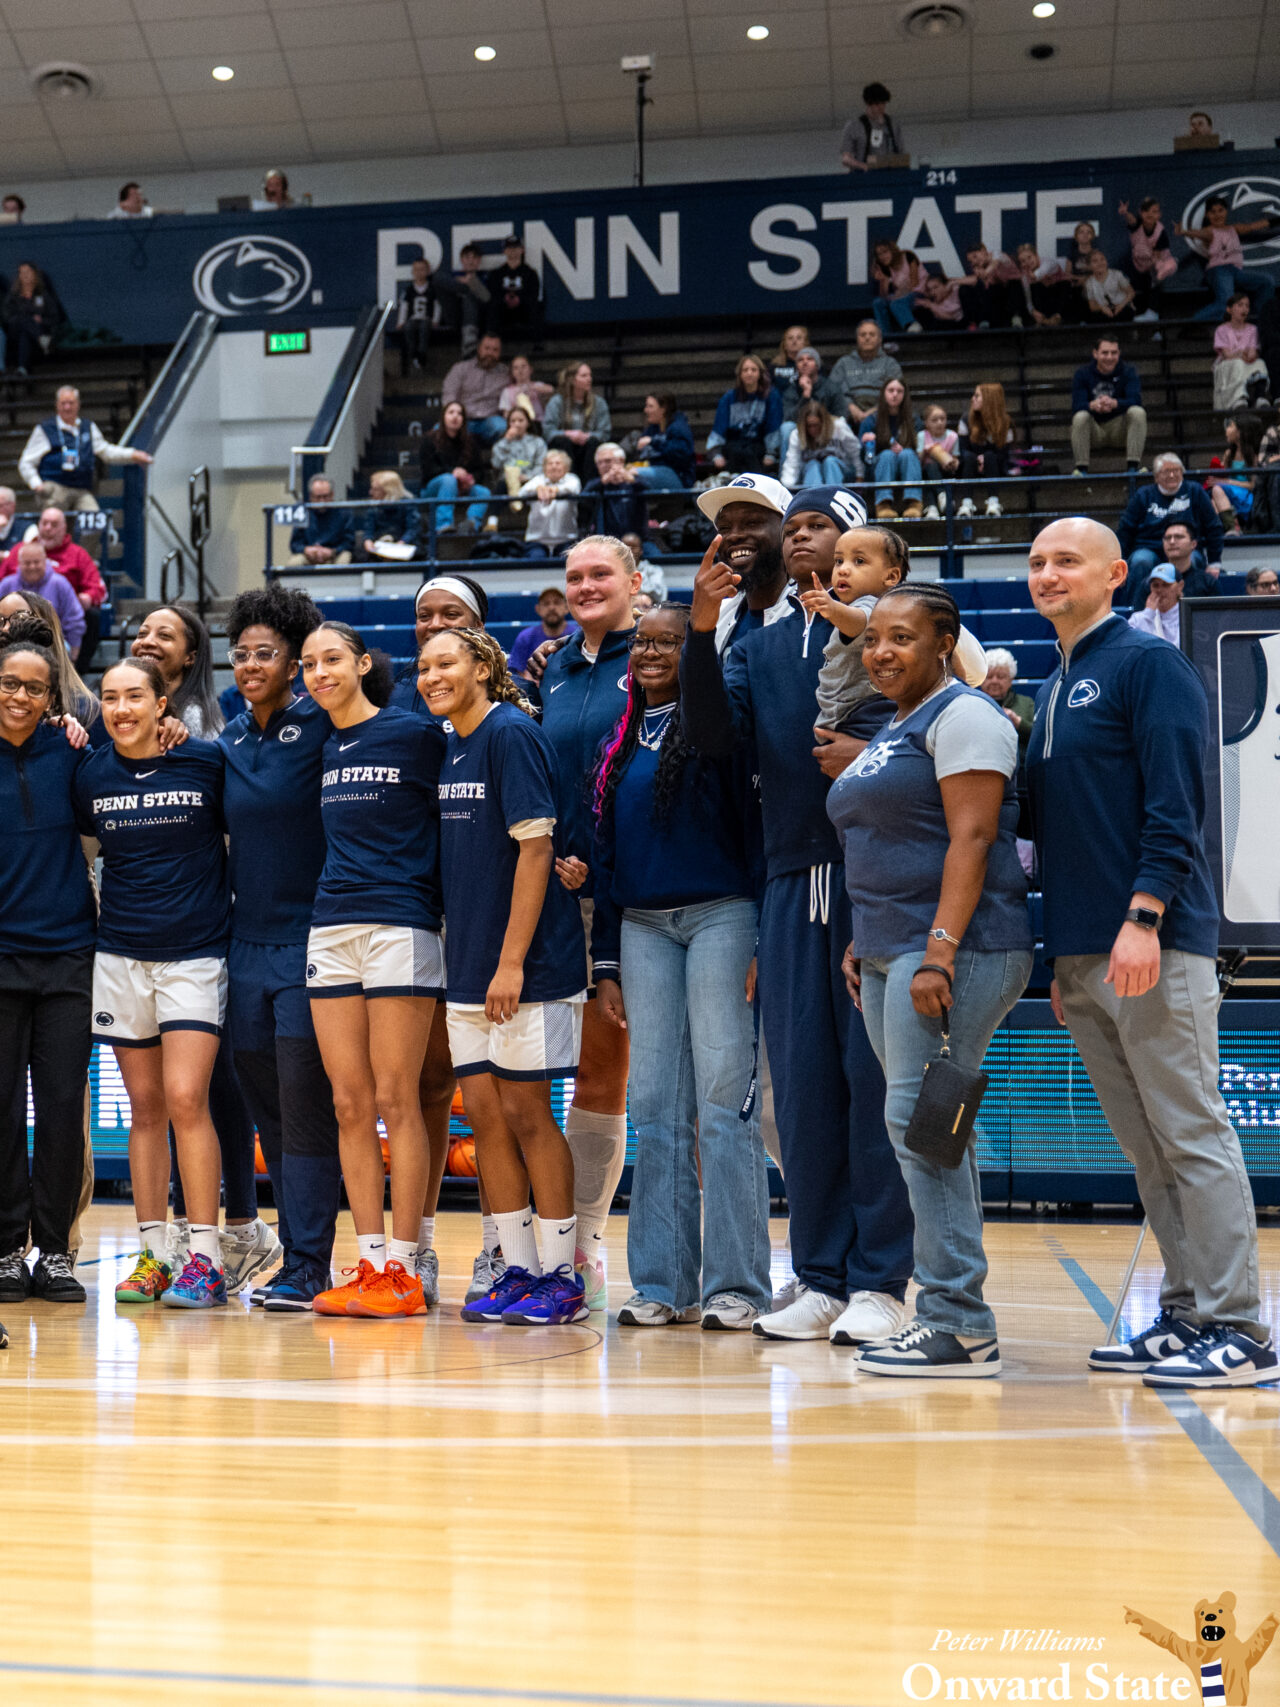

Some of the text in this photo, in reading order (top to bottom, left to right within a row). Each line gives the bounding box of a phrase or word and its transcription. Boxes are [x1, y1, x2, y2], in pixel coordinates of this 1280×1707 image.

[926, 170, 957, 186] 214
[77, 512, 107, 529] 113
[274, 506, 306, 524] 114
[321, 766, 401, 788] ENN STATE
[451, 782, 486, 799] STATE
[92, 790, 204, 815] PENN STATE
